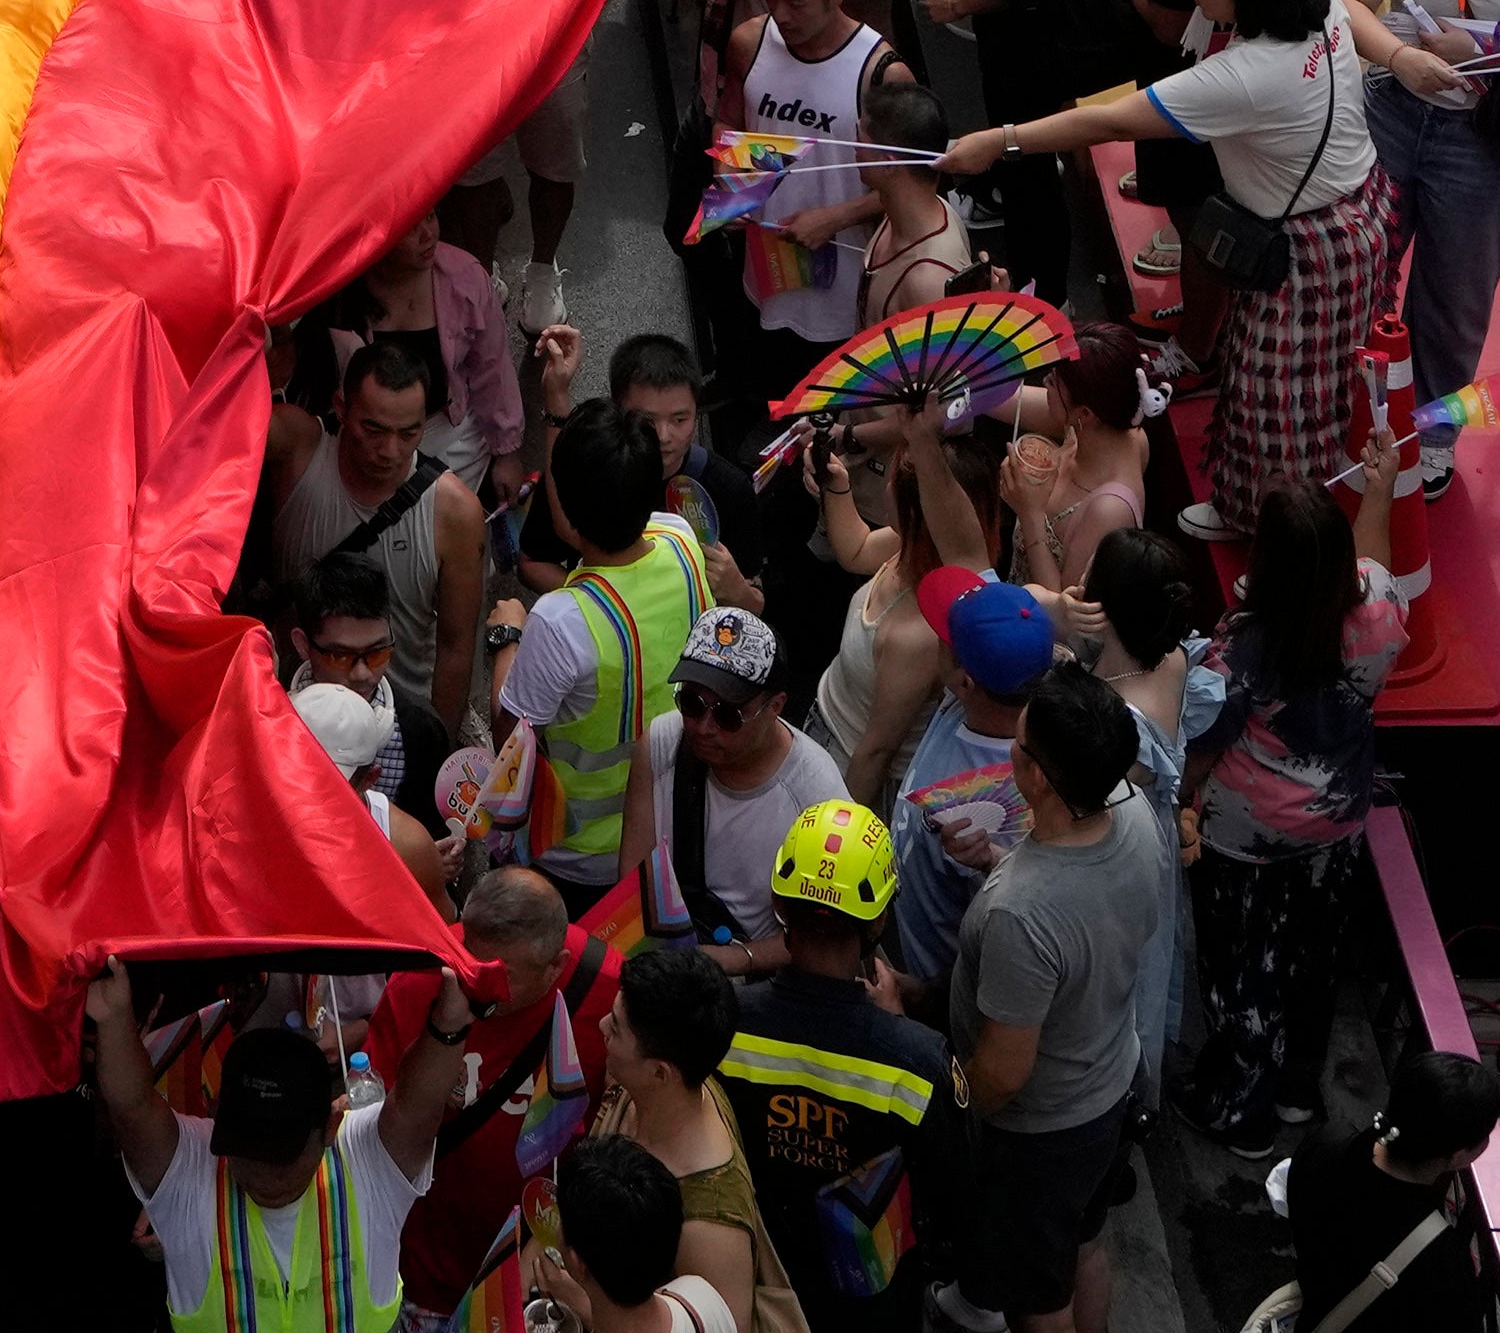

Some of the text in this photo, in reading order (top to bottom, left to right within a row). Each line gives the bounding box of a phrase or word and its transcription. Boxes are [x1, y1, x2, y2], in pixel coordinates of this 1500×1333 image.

[758, 94, 837, 133] hdex
[819, 859, 836, 880] 23
[799, 881, 842, 906] ป้องกัน
[768, 1094, 849, 1139] SPF
[767, 1128, 849, 1159] SUPER
[768, 1144, 849, 1173] FORCE
